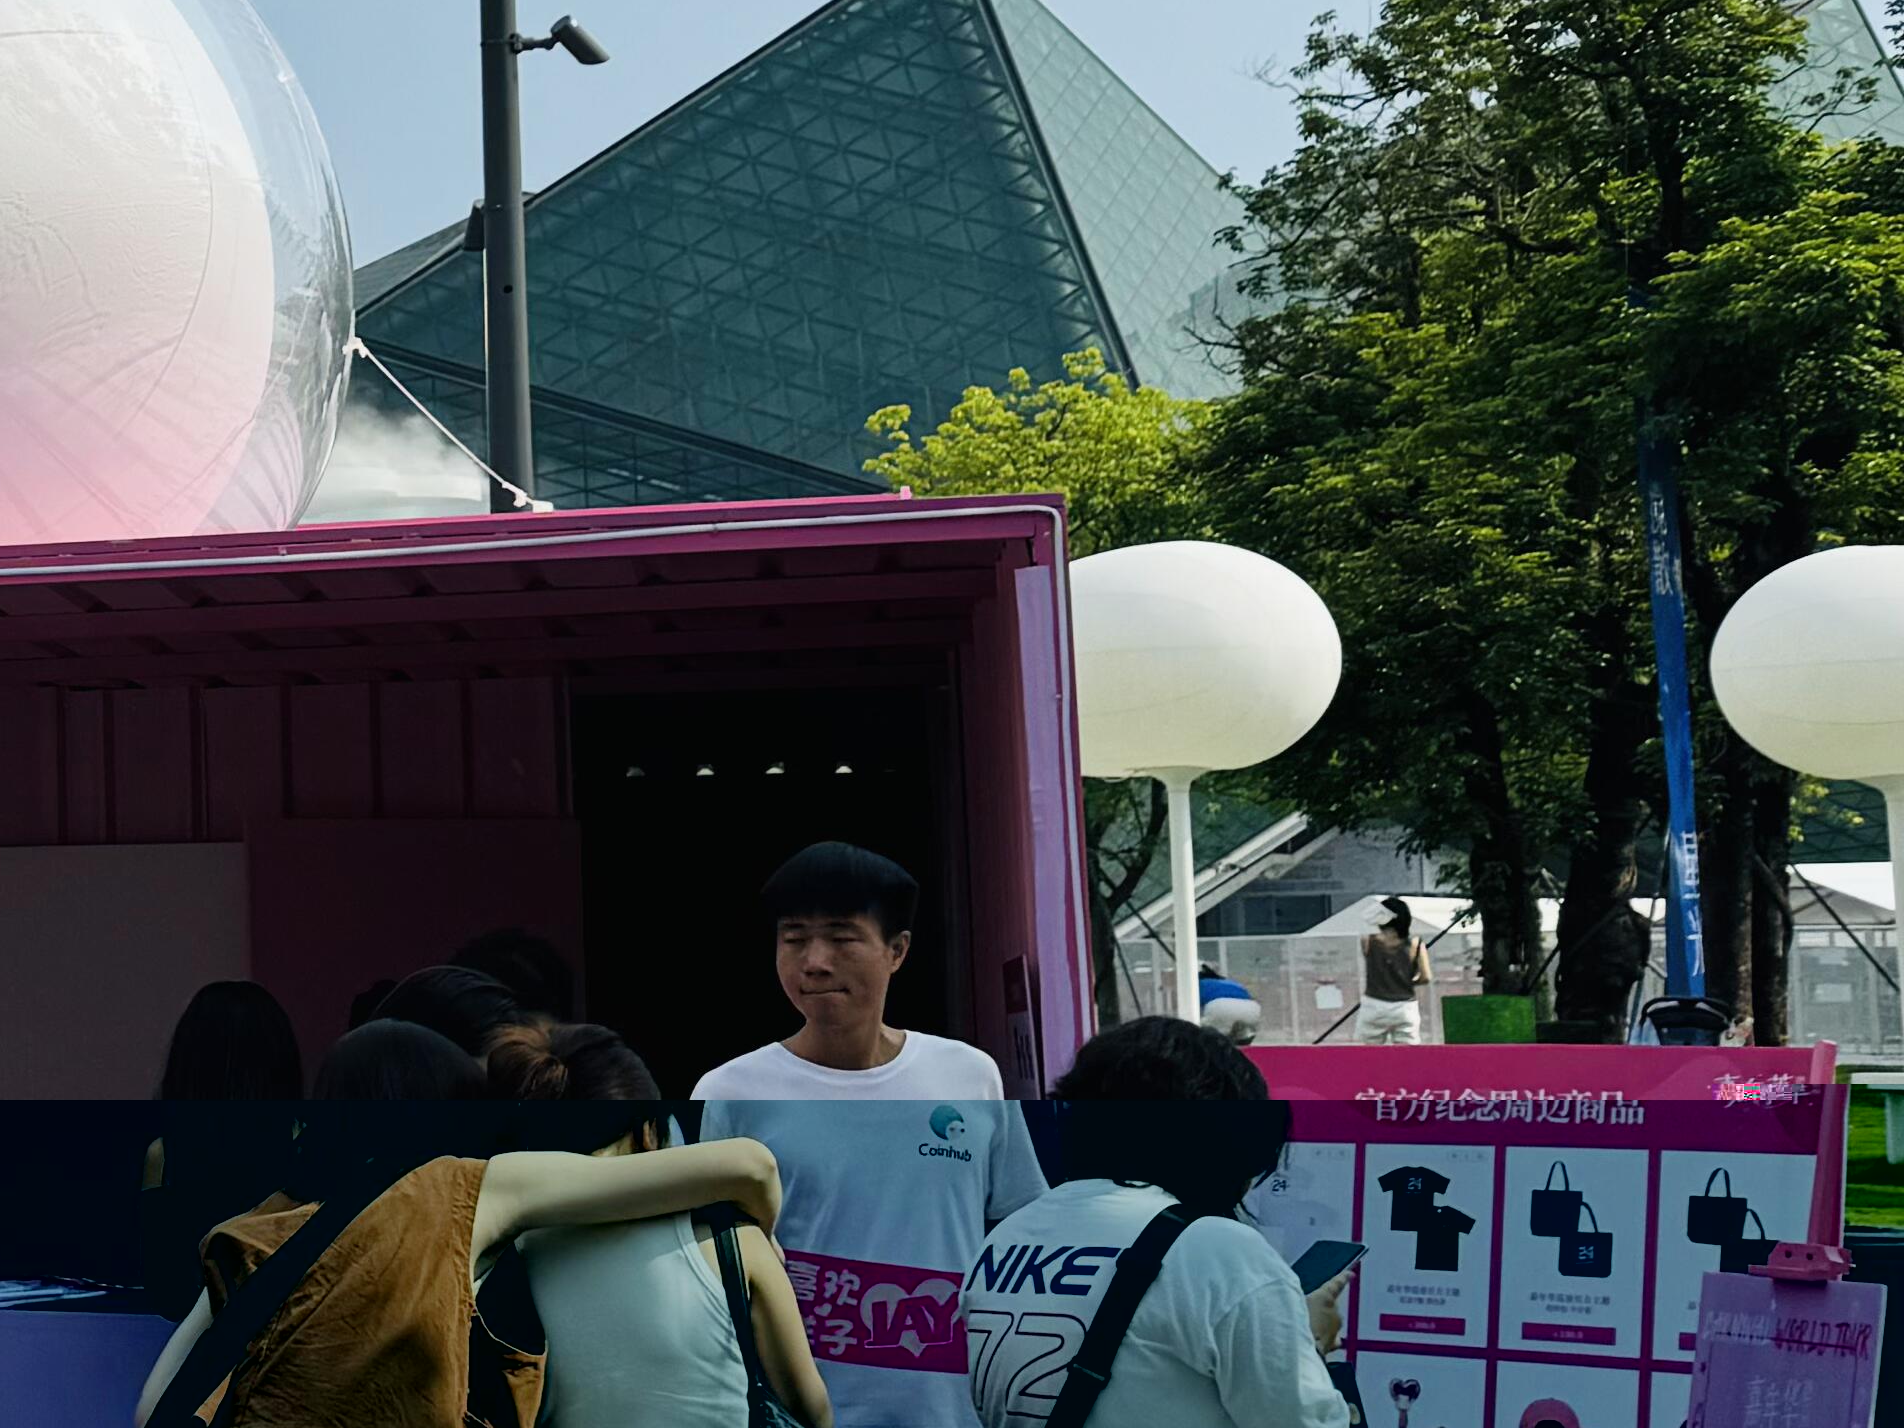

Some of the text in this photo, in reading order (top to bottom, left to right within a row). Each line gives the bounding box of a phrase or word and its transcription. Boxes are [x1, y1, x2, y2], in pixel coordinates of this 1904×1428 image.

[1354, 1088, 1645, 1125] 官方纪念周边商品
[918, 1143, 972, 1162] Coinhub
[964, 1244, 1123, 1297] NIKE
